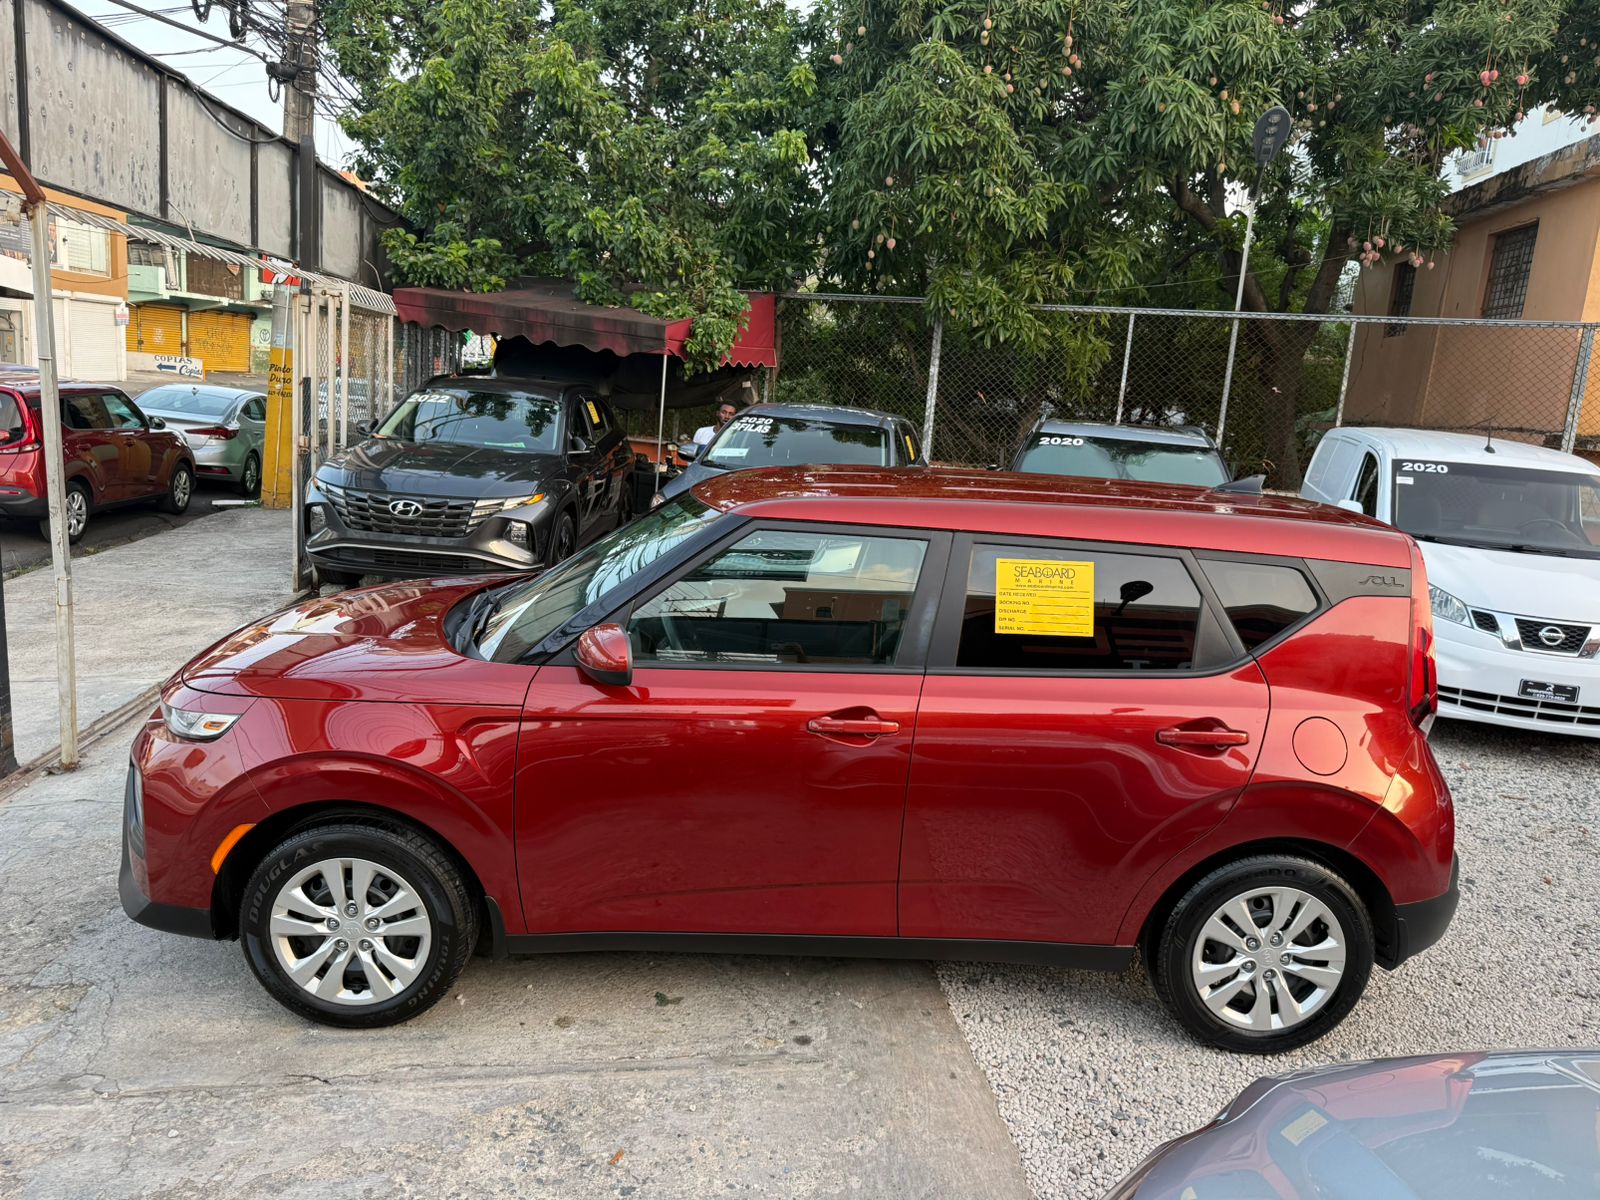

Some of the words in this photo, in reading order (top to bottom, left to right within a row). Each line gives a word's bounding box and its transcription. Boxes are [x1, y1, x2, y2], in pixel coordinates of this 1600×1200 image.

[154, 355, 193, 364] COPIAS
[179, 365, 203, 376] Copias
[407, 394, 451, 403] 2022
[739, 416, 774, 425] 2020
[1039, 436, 1084, 446] 2020
[1401, 462, 1449, 474] 2020
[1014, 567, 1076, 579] SEABOARD
[248, 841, 325, 924] DOUGLAS
[407, 933, 449, 1009] TOURING
